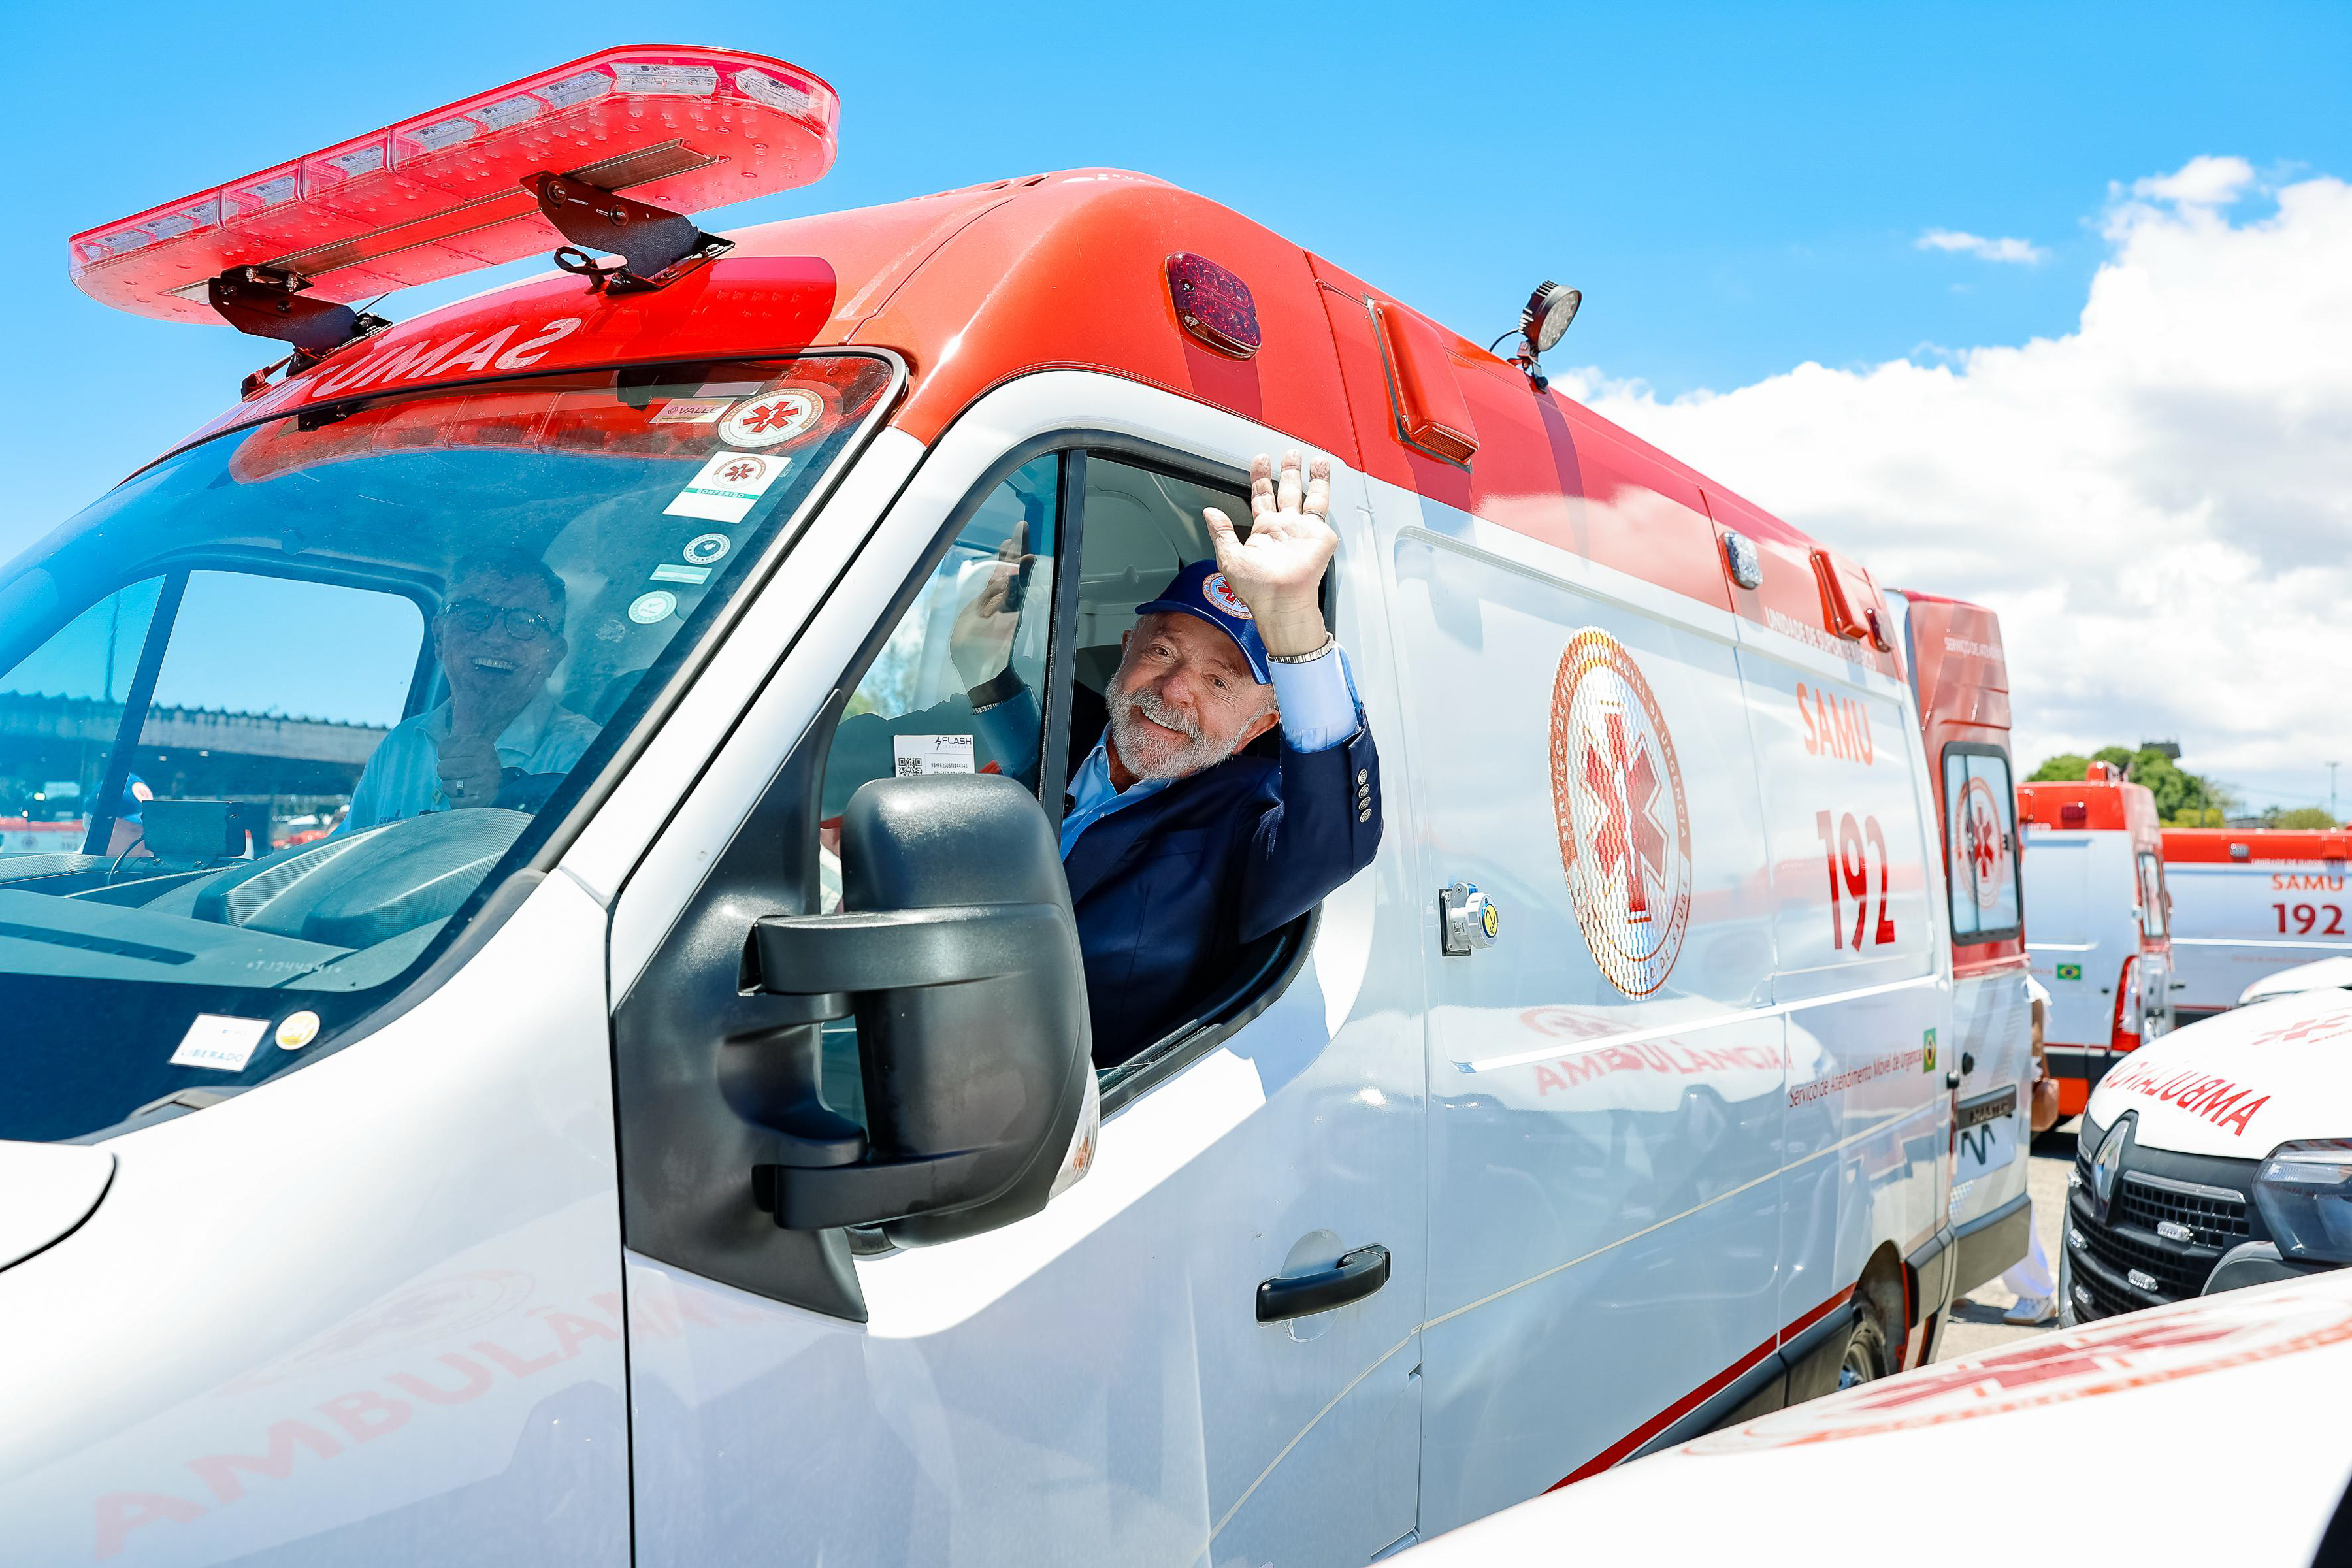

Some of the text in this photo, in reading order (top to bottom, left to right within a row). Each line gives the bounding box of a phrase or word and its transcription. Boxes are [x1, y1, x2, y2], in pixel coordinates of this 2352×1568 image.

[696, 488, 745, 498] CONFERIDO
[1796, 681, 1874, 766] SAMU
[942, 736, 972, 745] FLASH
[1816, 810, 1895, 952] 192
[2271, 873, 2344, 892] SAMU
[2272, 903, 2345, 936] 192
[1489, 926, 1495, 934] AC
